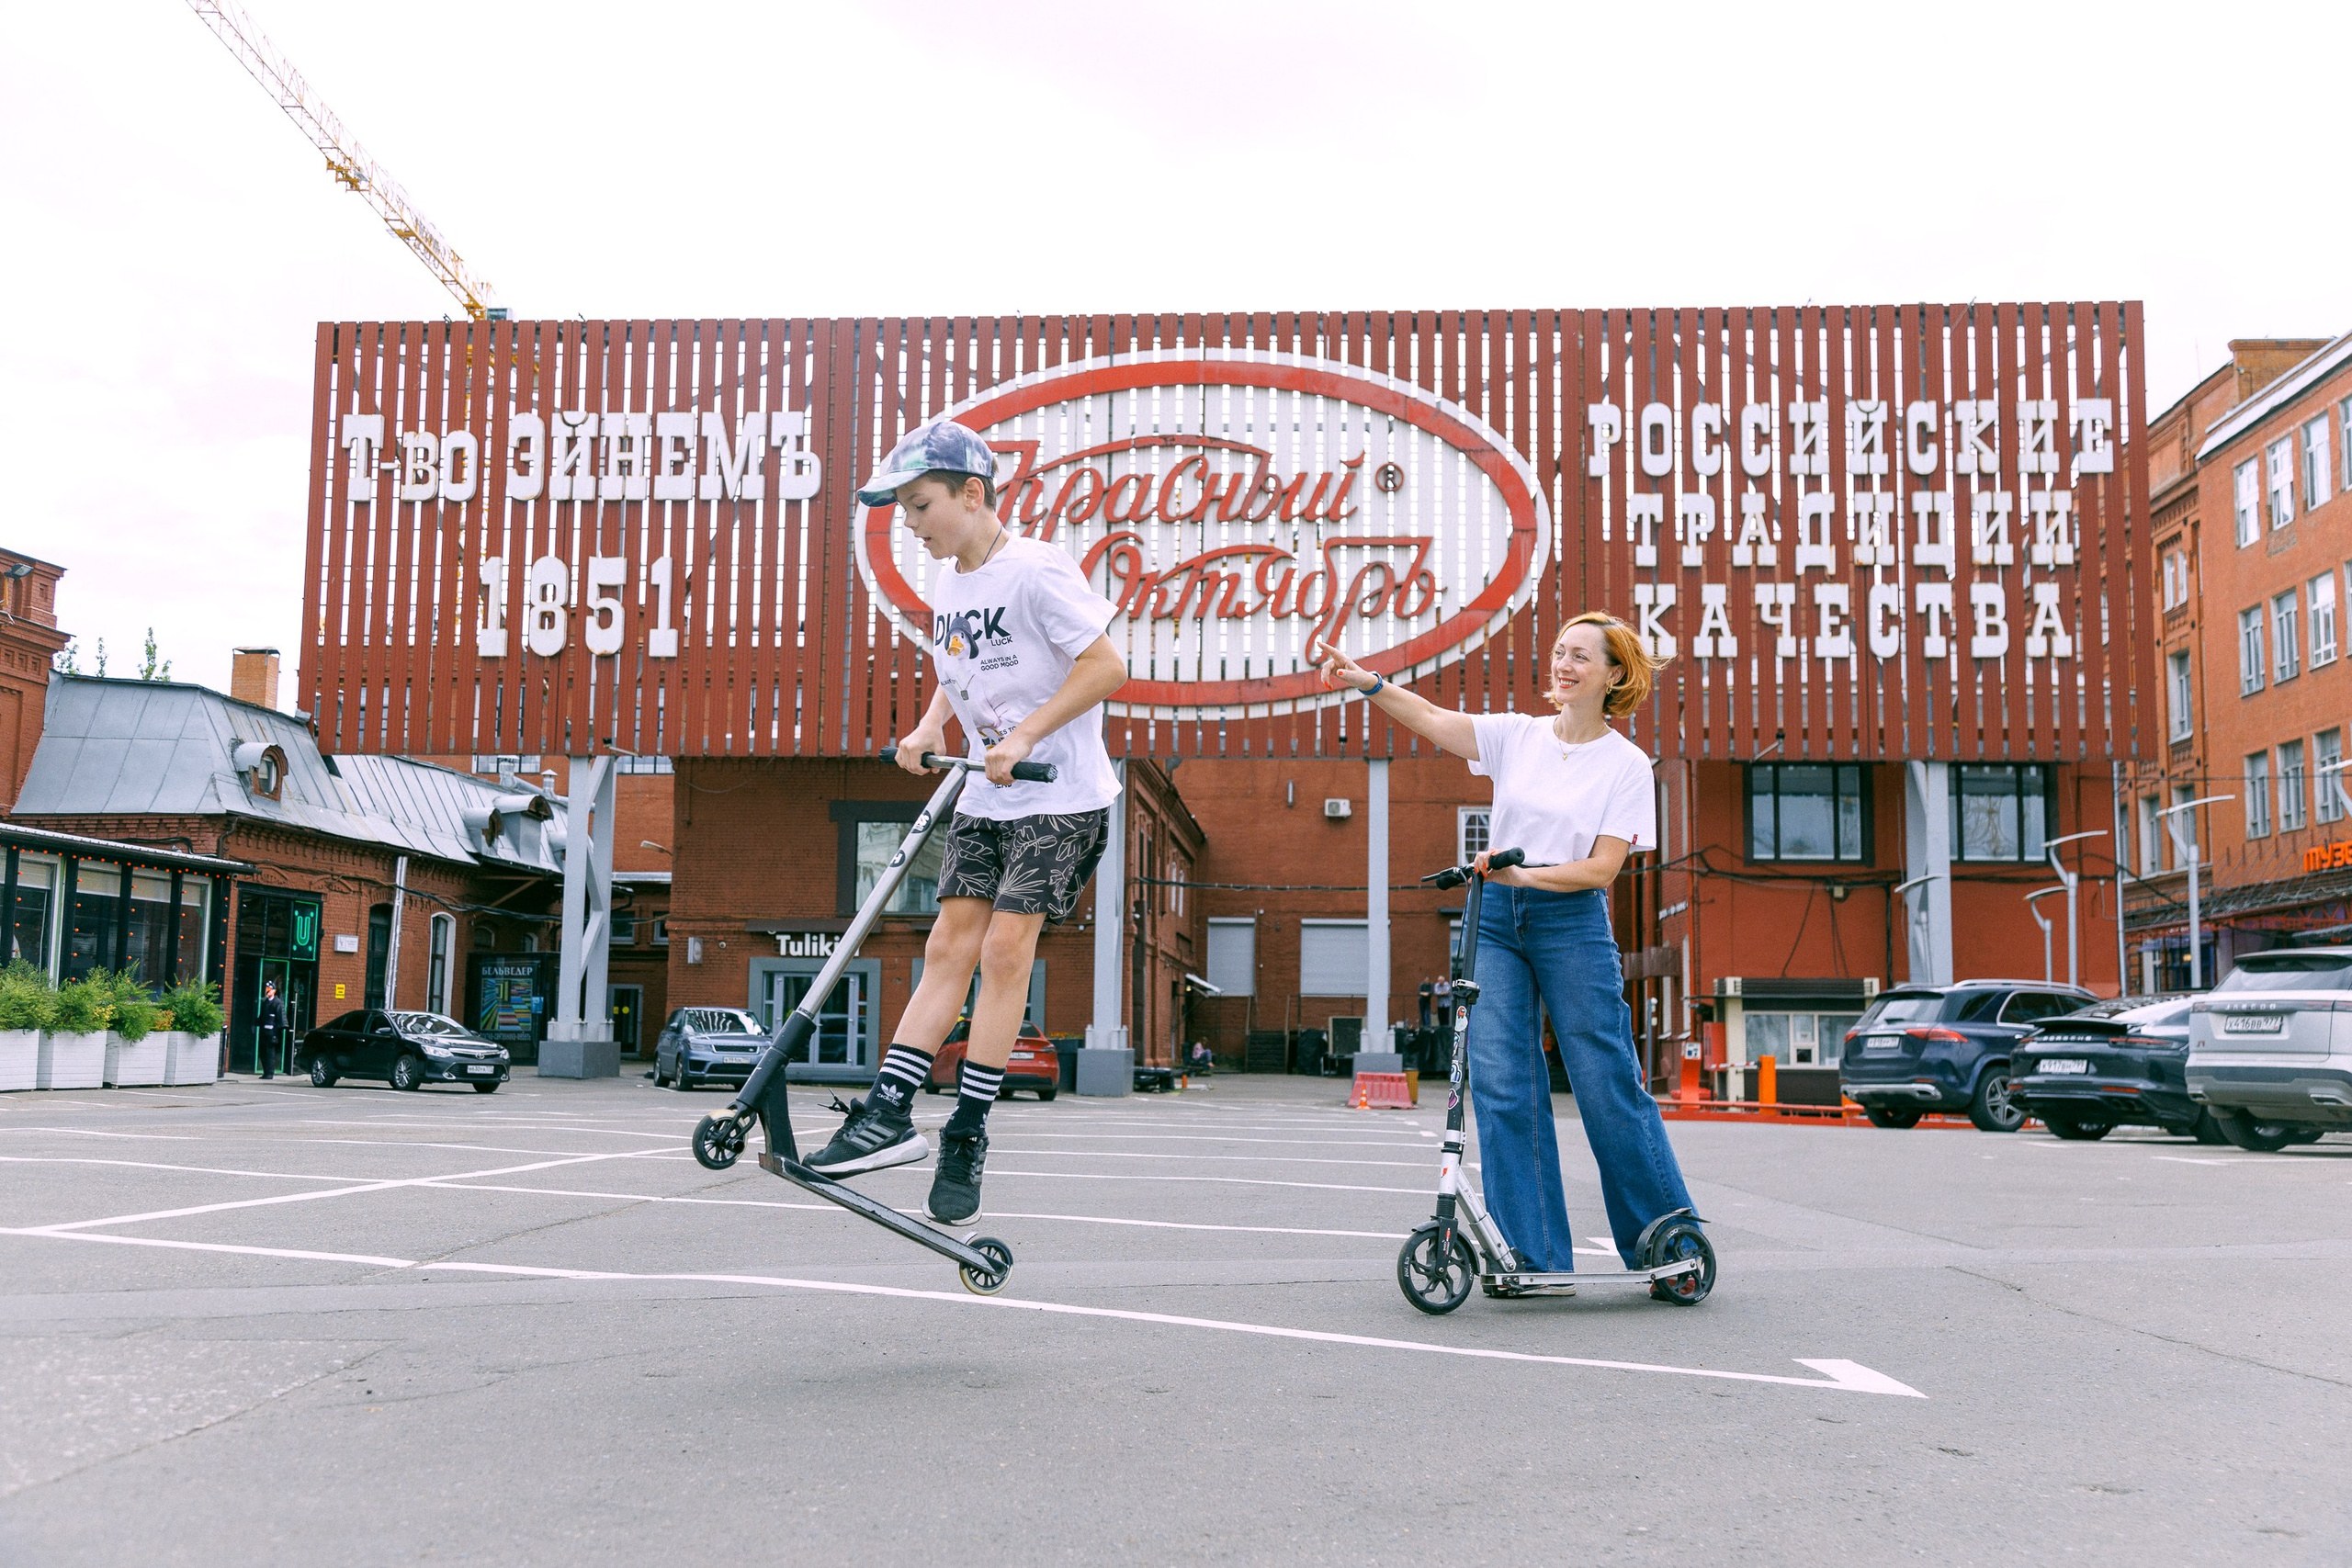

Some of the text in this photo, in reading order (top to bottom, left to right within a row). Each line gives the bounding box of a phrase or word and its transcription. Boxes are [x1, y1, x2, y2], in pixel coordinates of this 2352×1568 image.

[506, 411, 822, 502] ЭЙНЕМЪ
[1588, 398, 2114, 477] РОССИЙСКИЕ
[1629, 490, 2075, 581] ТРАДИЦИИ
[478, 556, 678, 658] 1851
[1081, 530, 1446, 665] Октябрь
[1634, 582, 2074, 659] КАЧЕСТВА
[980, 656, 1005, 665] ALWAYS
[980, 660, 1019, 671] GOOD MOOD
[990, 637, 1013, 647] LUCK
[481, 966, 533, 976] БЕЛЬВЕДЕР
